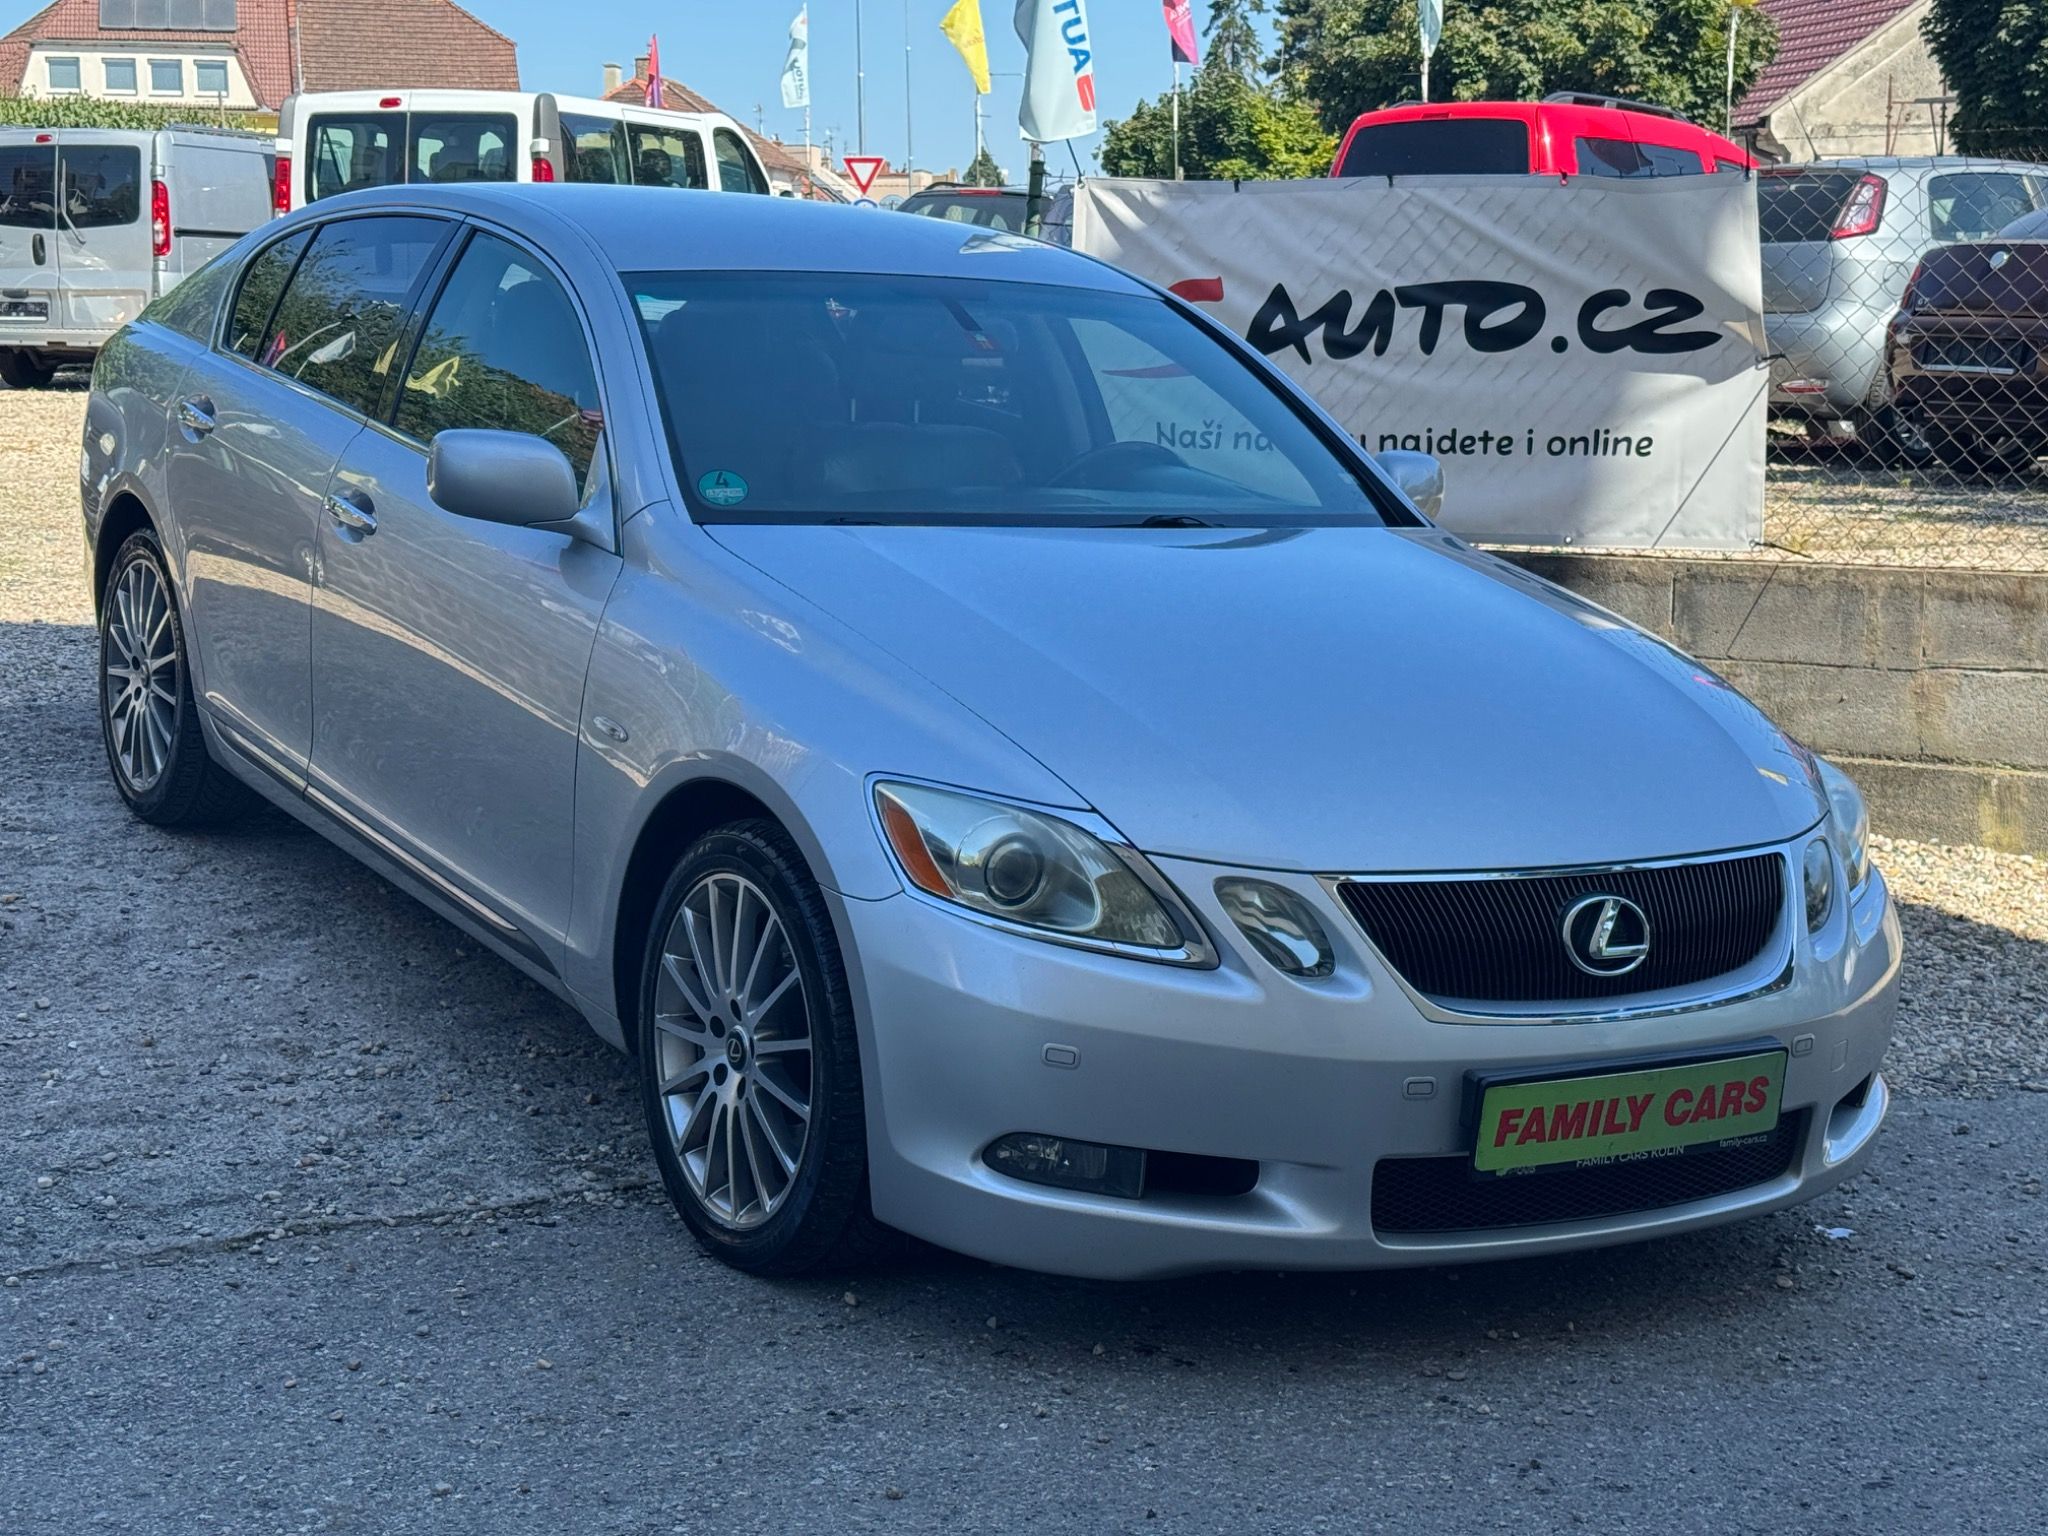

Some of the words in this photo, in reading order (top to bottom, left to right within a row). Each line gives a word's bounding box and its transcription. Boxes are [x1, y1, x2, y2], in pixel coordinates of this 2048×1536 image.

[1156, 420, 1222, 450] Naši
[1379, 427, 1513, 456] najdete
[1526, 428, 1534, 456] i
[1547, 428, 1654, 457] online
[1493, 1092, 1656, 1148] FAMILY
[1664, 1075, 1770, 1127] CARS
[1576, 1153, 1616, 1168] FAMILY
[1619, 1149, 1649, 1163] CARS
